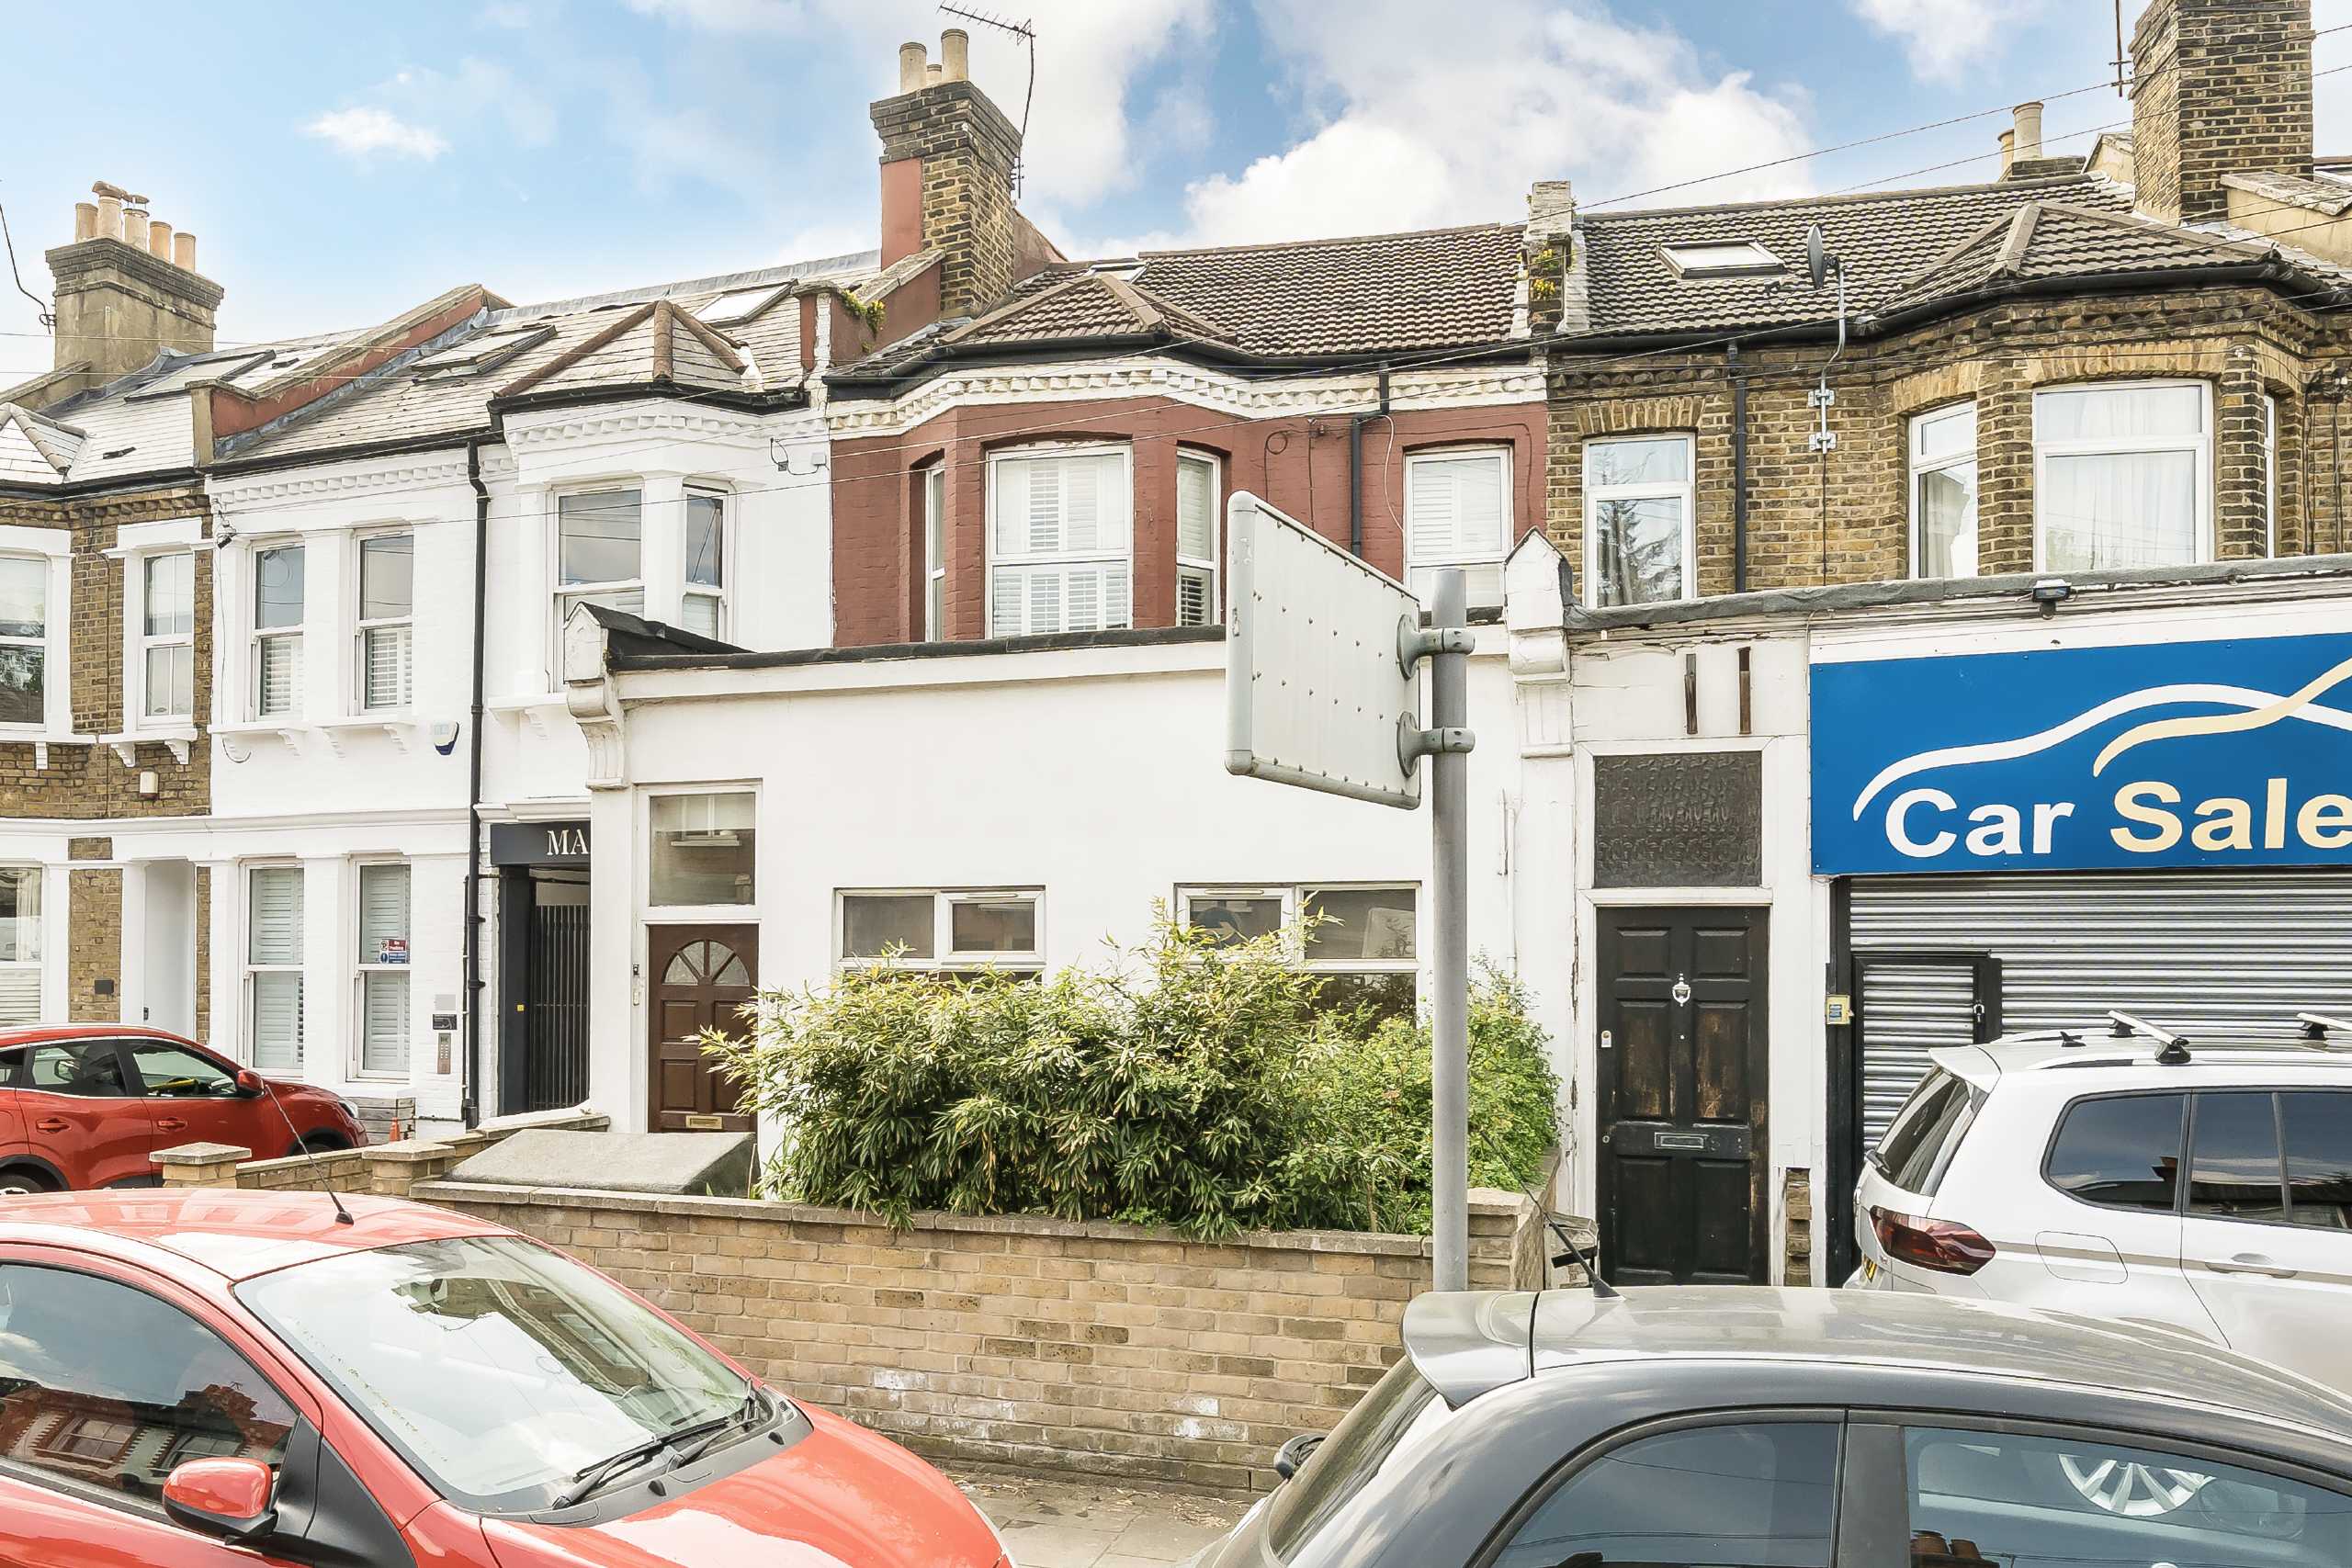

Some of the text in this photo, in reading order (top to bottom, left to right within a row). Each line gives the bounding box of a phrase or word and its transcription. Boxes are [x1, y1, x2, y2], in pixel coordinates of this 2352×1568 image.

[547, 829, 589, 855] MA
[1885, 778, 2352, 858] Car Sale
